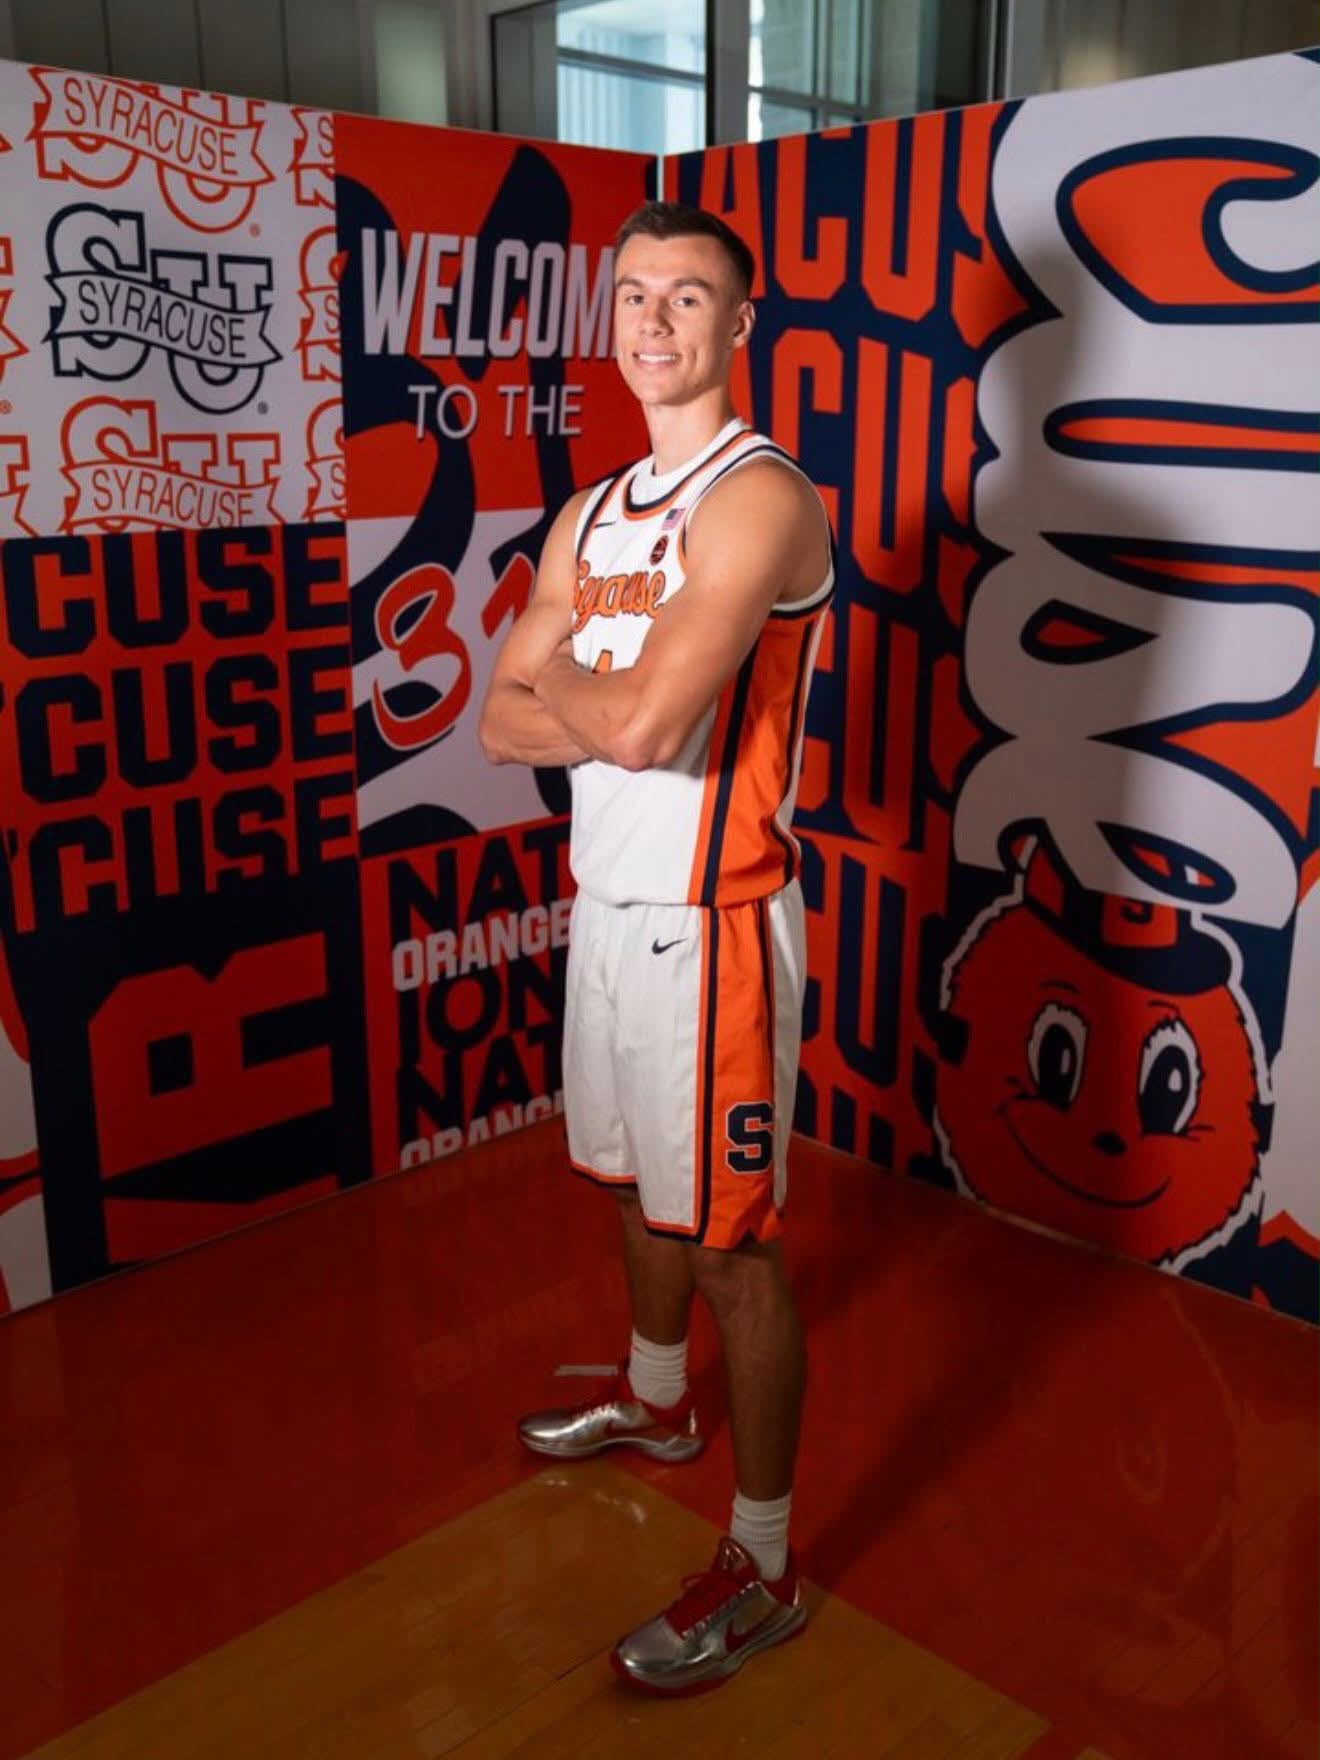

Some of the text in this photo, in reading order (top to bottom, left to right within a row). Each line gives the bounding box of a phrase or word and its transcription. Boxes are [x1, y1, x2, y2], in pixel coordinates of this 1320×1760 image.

[63, 77, 239, 176] SYRACUSE
[44, 202, 274, 415] SU
[78, 279, 246, 359] SYRACUSE
[361, 227, 618, 359] WELCOM
[407, 383, 585, 439] TO THE
[91, 468, 254, 529] SYRACUSE
[2, 521, 351, 660] CUSE
[0, 642, 354, 804] CUSE
[5, 770, 358, 928] CUSE
[388, 828, 573, 943] NAT
[391, 897, 574, 993] ORANGE
[725, 1100, 774, 1173] S
